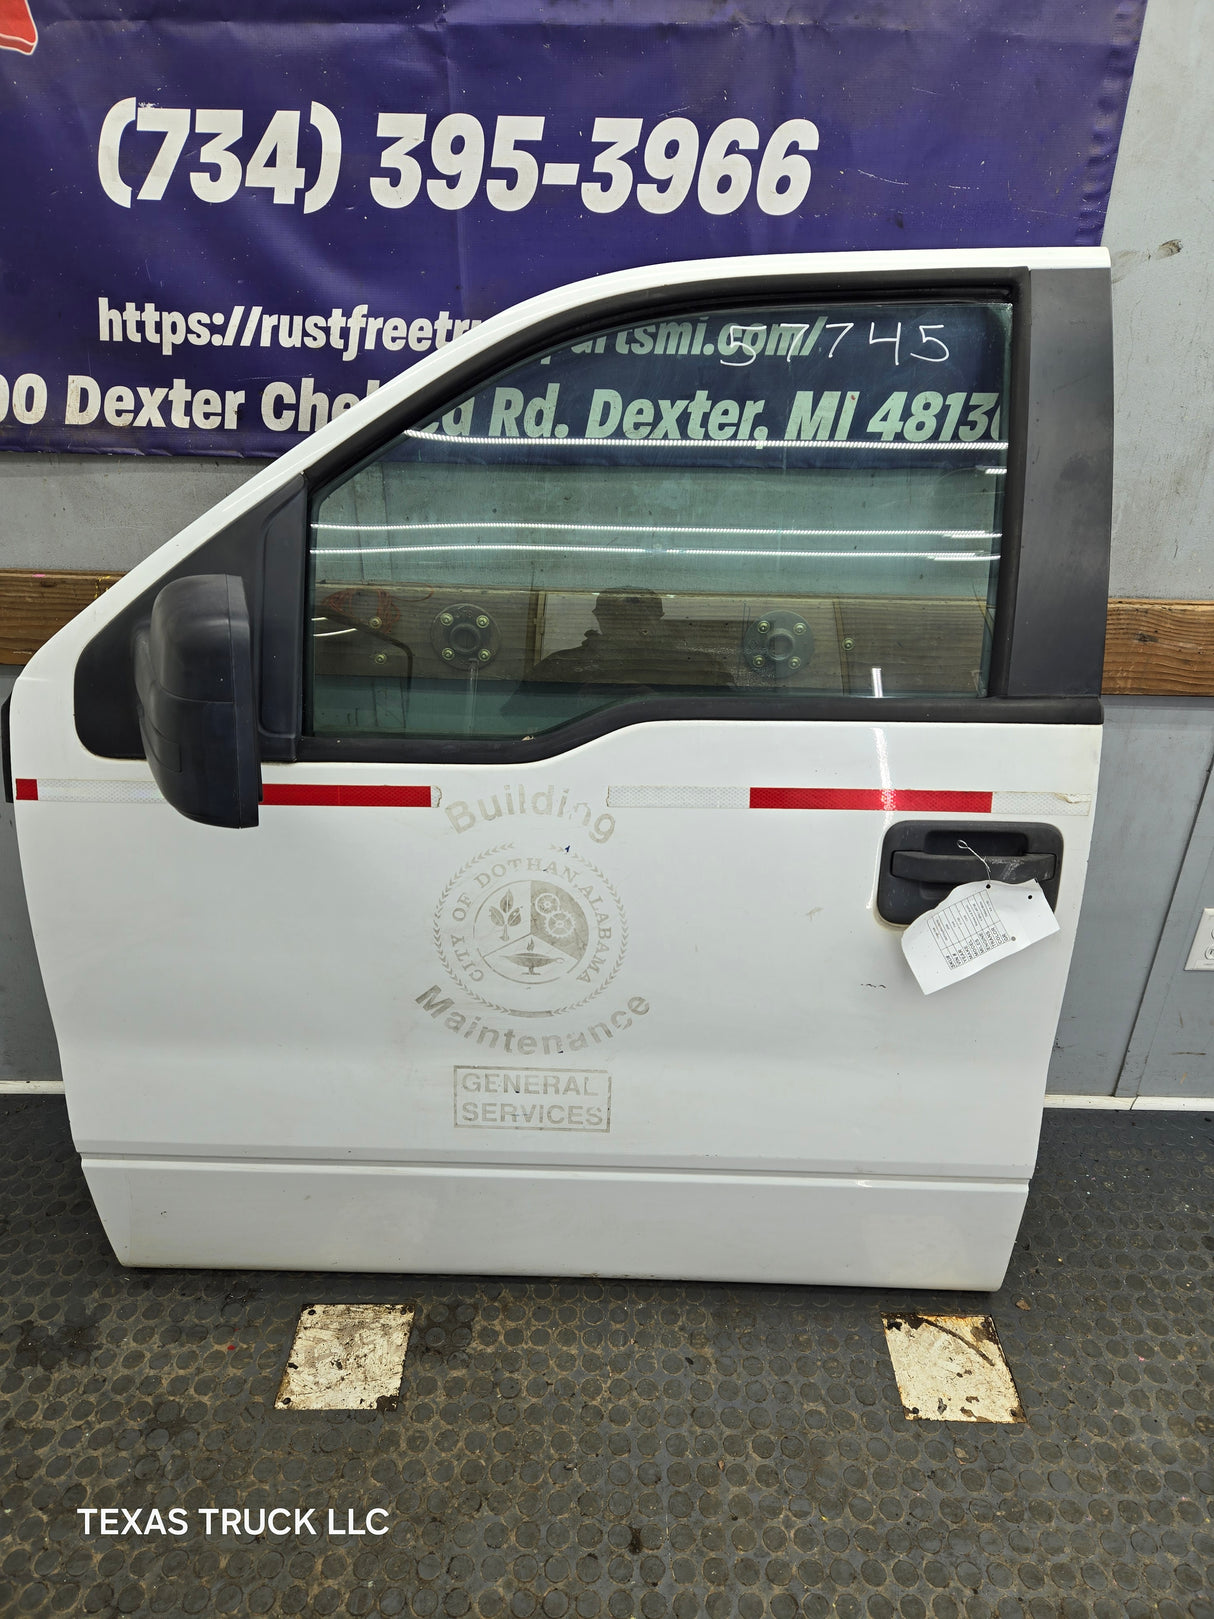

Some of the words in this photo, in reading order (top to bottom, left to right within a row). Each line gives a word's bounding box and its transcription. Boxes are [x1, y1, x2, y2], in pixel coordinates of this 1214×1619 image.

[98, 97, 342, 214] (734)
[369, 112, 820, 217] 395-3966
[719, 321, 950, 367] 57745
[65, 374, 246, 430] Dexter
[488, 383, 569, 438] Rd.
[585, 388, 769, 449] Dexter,
[784, 390, 860, 441] MI
[444, 783, 616, 844] Building
[452, 892, 472, 922] OF
[450, 934, 485, 983] CITY
[576, 884, 612, 984] ALABAMA
[990, 926, 1002, 944] COLOR
[415, 984, 650, 1056] Maintenance
[461, 1072, 600, 1097] GENERAL
[461, 1101, 604, 1127] SERVICES
